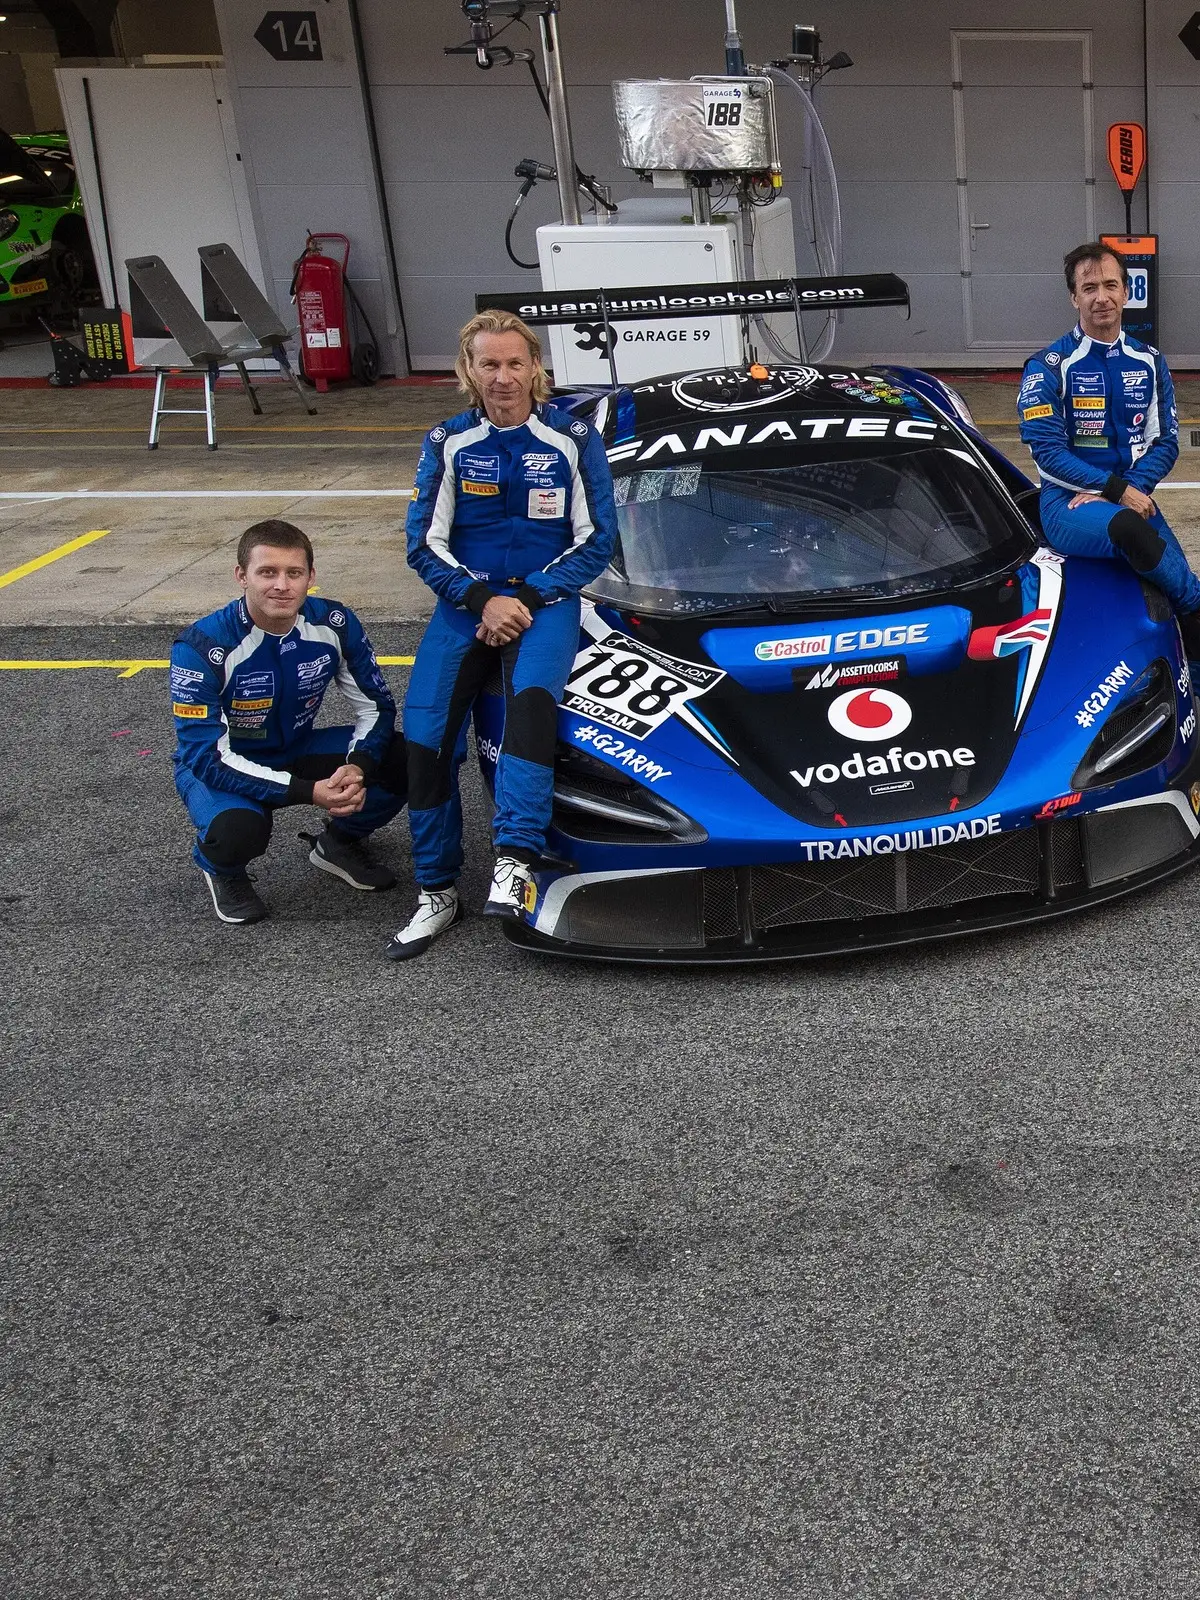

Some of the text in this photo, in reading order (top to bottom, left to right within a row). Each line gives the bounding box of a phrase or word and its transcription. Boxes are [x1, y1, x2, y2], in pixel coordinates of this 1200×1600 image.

[272, 20, 317, 52] 14
[707, 103, 742, 126] 188
[1119, 127, 1133, 176] READY
[1123, 253, 1152, 261] AGE 59
[518, 285, 865, 314] quantumloophole.com
[1127, 274, 1147, 301] 88
[84, 323, 93, 339] START
[93, 323, 104, 358] 1ST GEAR
[101, 323, 114, 360] CHECK RADIO
[111, 323, 123, 360] DRIVER ID
[622, 330, 688, 342] GARAGE
[692, 328, 711, 341] 59
[608, 416, 937, 463] FANATEC
[774, 623, 930, 657] Castrol EDGE
[566, 651, 689, 716] 188
[837, 671, 899, 686] COMPETIZIONE
[840, 661, 899, 677] ASSETTO CORSA
[1074, 660, 1134, 728] #G2ARMY
[566, 696, 637, 731] PRO-AM
[573, 725, 672, 782] #G2ARMY
[789, 747, 977, 788] vodafone
[1054, 792, 1082, 806] TOW
[800, 813, 1002, 862] TRANQUILIDADE
